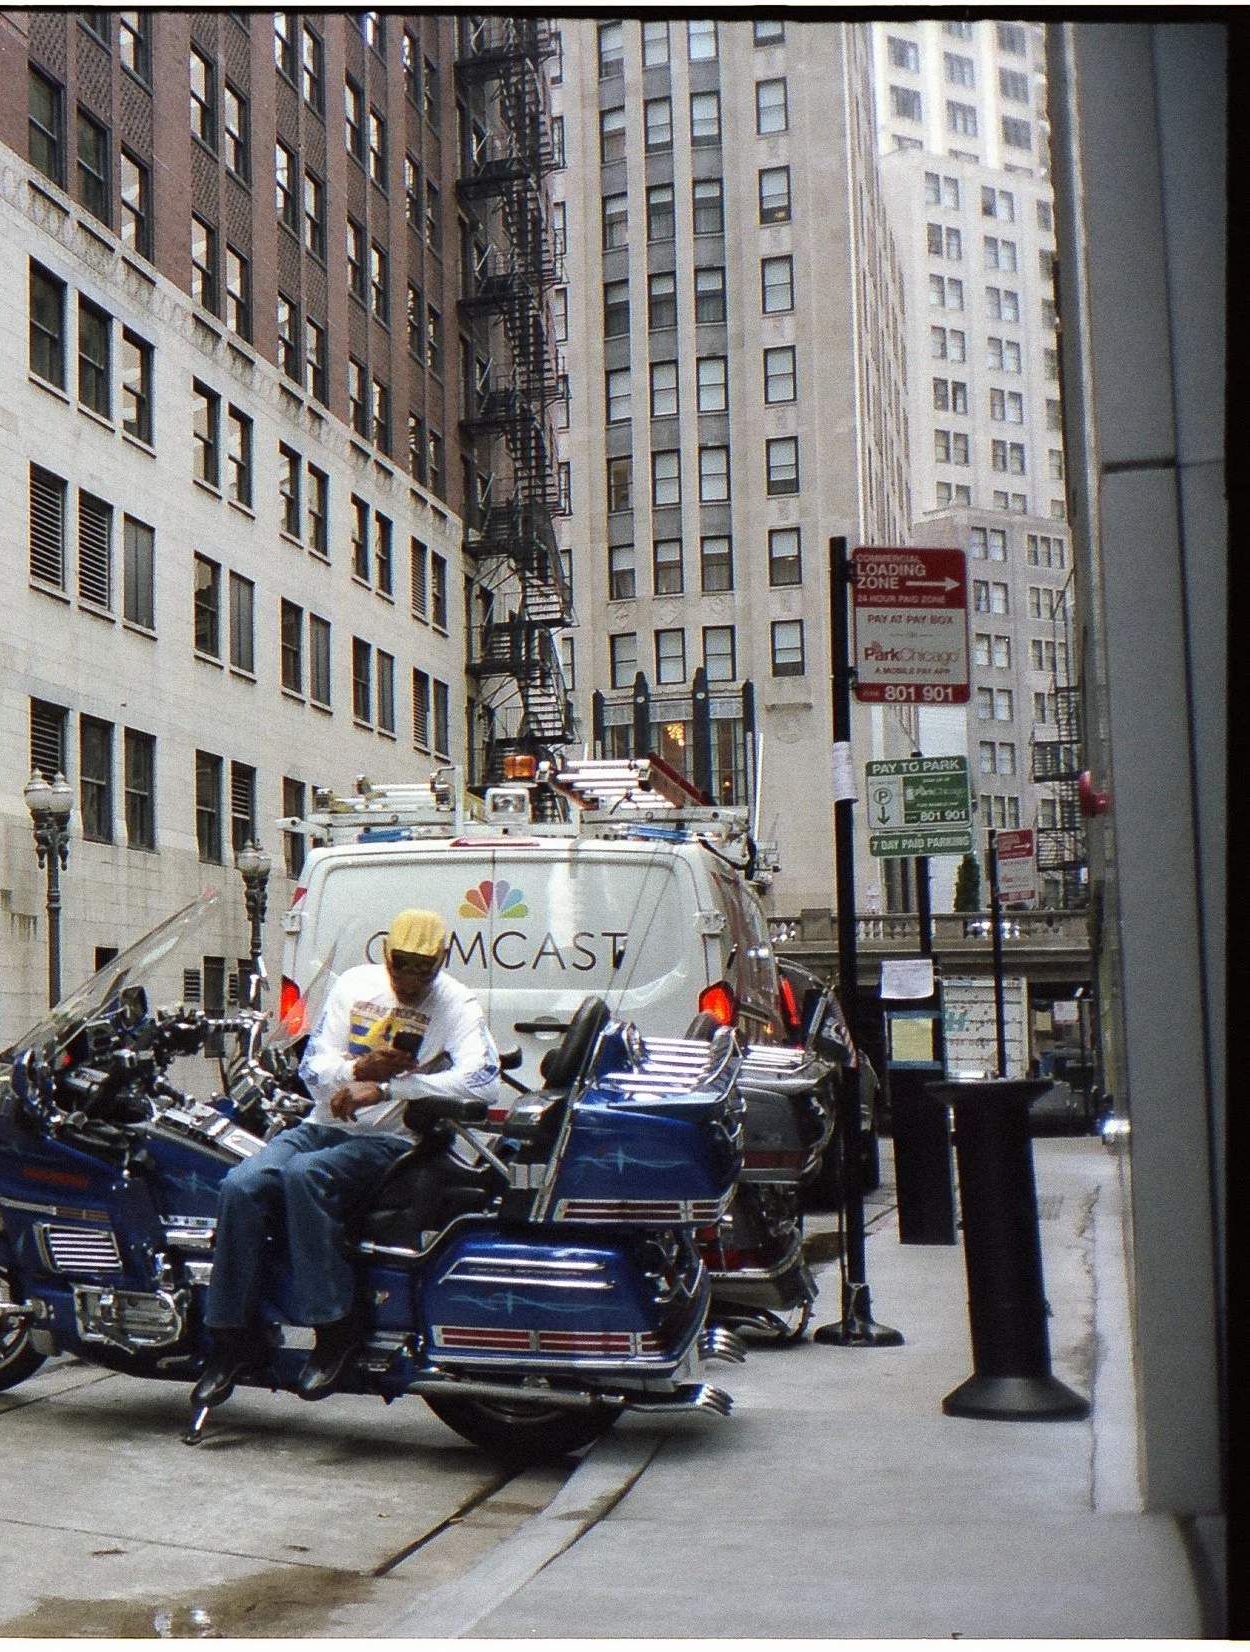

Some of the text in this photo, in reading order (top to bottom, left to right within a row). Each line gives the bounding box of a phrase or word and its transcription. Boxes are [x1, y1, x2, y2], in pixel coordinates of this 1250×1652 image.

[856, 554, 922, 563] COMMERCIAL
[856, 563, 926, 576] LOADING
[857, 576, 900, 589] ZONE
[857, 595, 868, 603] 24
[870, 595, 896, 603] HOUR
[867, 614, 953, 624] PAY AT PAY BOX
[864, 646, 958, 666] ParkChicago
[884, 685, 916, 701] 801
[922, 686, 954, 701] 901
[872, 759, 960, 774] PAY TO PARK
[920, 810, 941, 822] 801
[944, 809, 966, 820] 901
[872, 836, 969, 850] 7 DAY PAID PARKING
[365, 930, 629, 971] CMCAST
